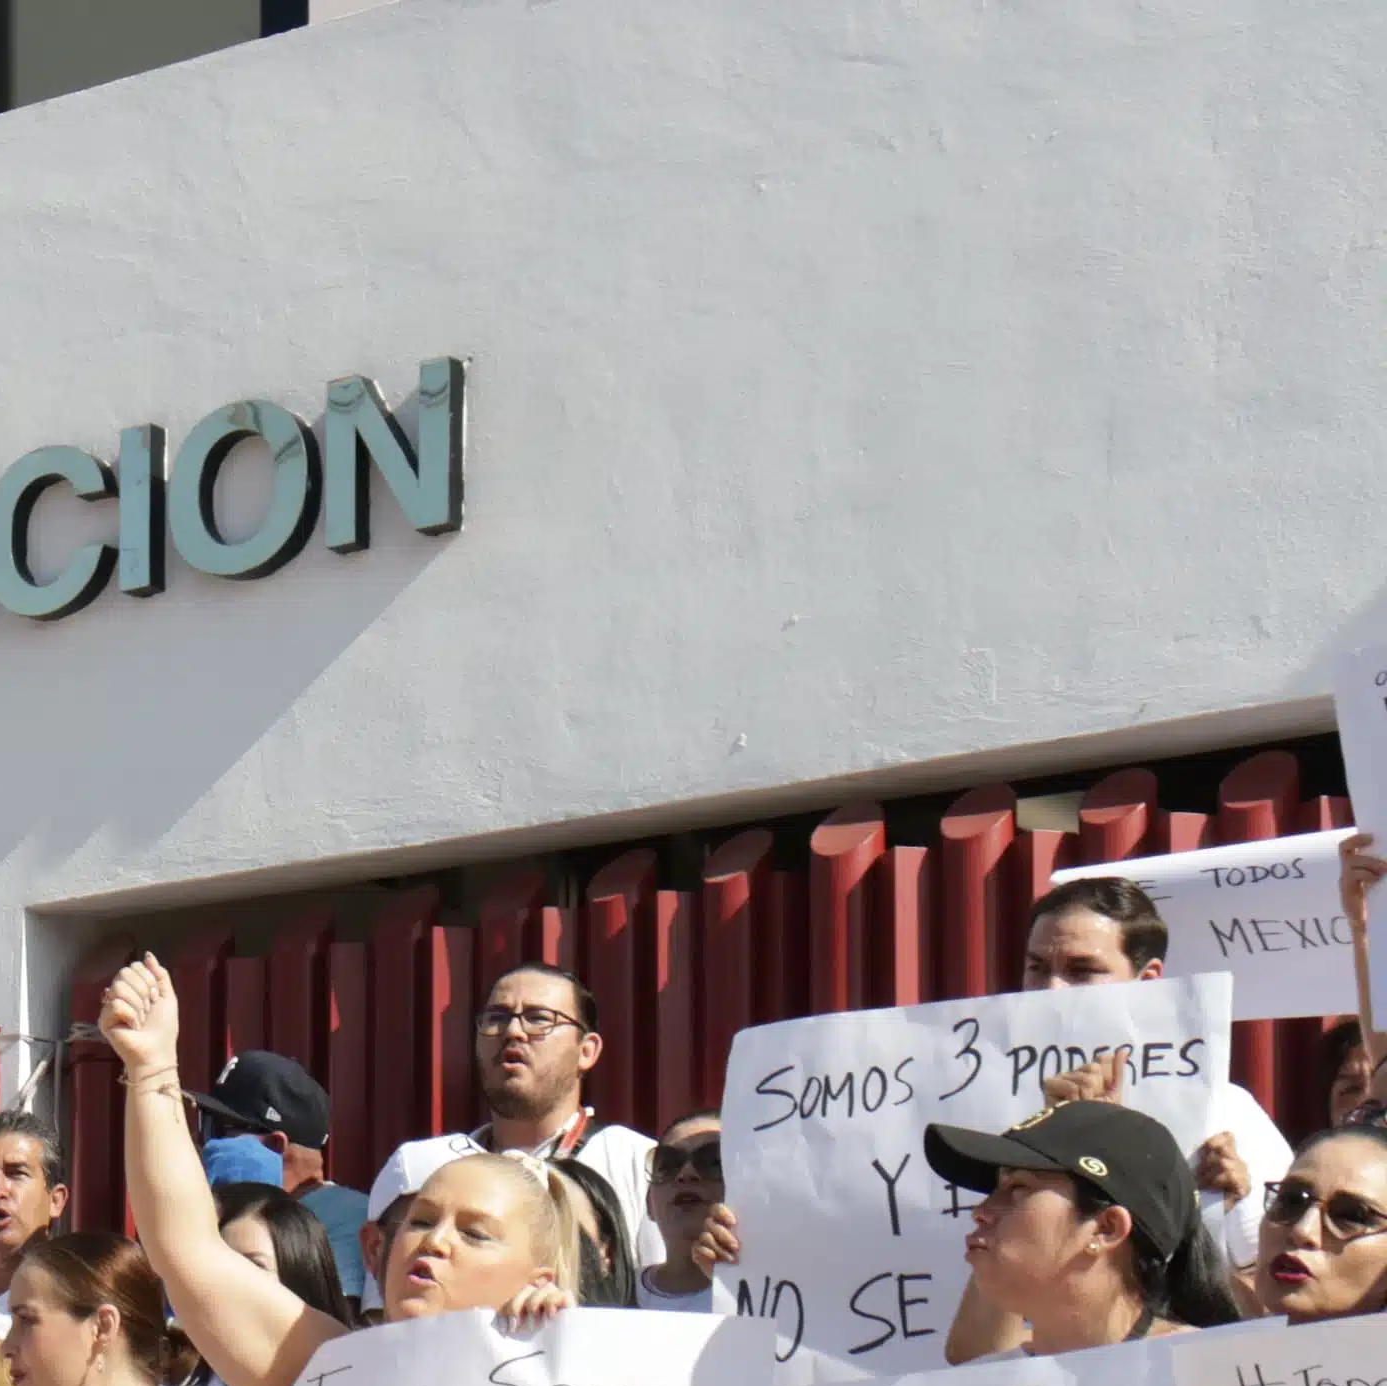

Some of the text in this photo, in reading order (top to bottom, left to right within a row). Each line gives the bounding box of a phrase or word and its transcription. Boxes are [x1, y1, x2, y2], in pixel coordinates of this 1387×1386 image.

[1200, 857, 1306, 889] TODOS
[753, 1056, 915, 1131] SOMOS
[939, 1017, 982, 1100] 3
[872, 1153, 911, 1236] Y
[848, 1271, 937, 1356] SE
